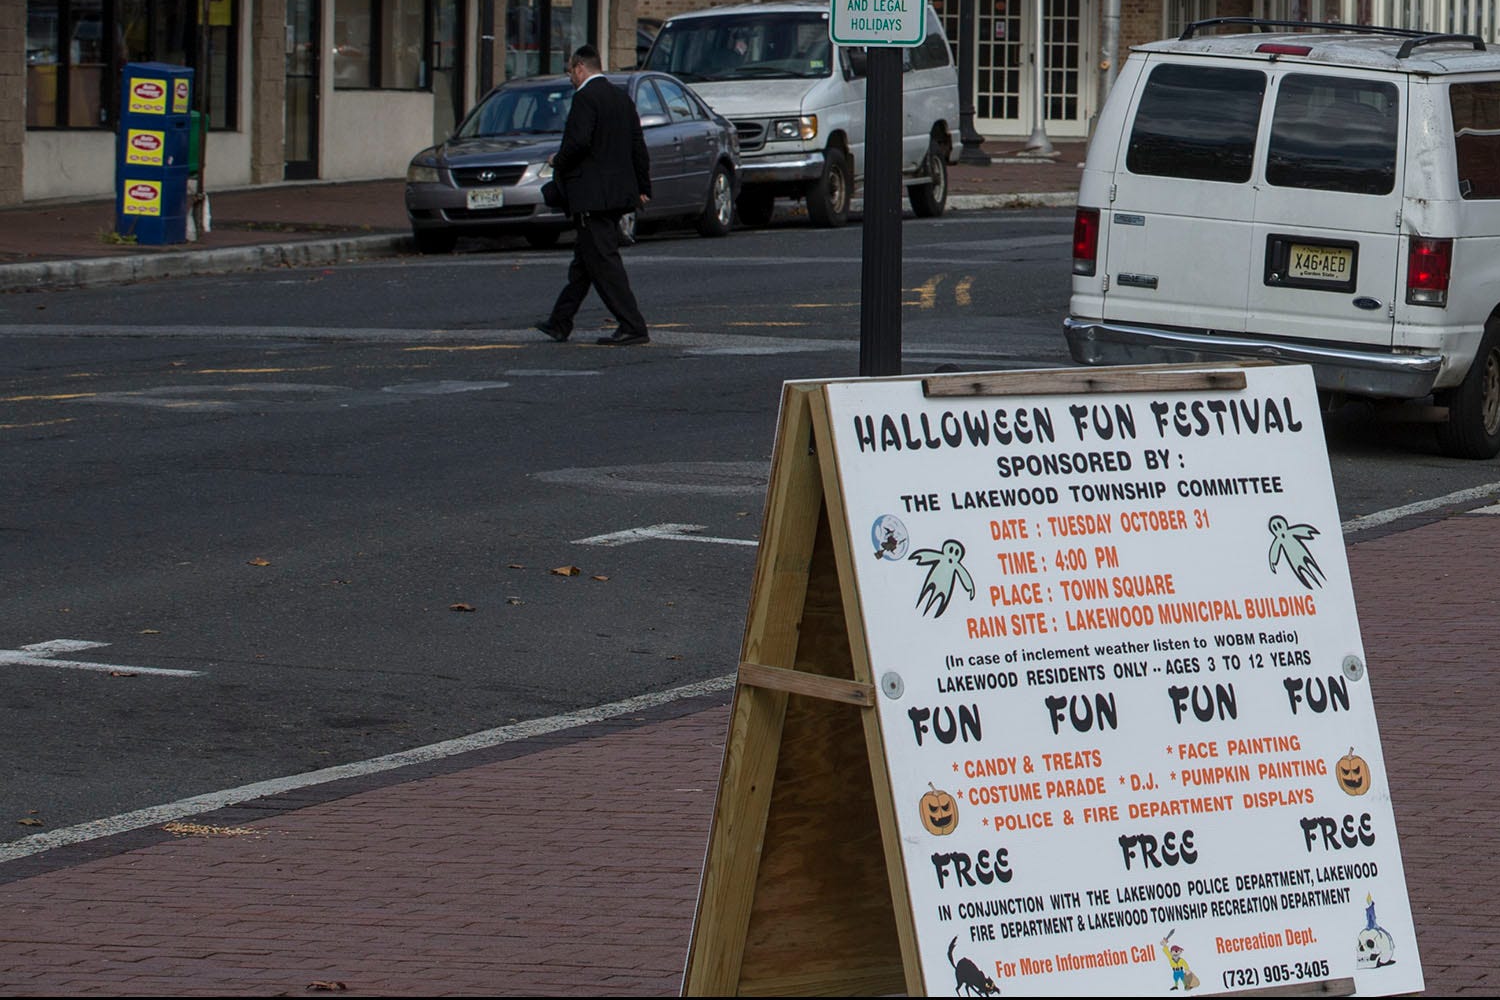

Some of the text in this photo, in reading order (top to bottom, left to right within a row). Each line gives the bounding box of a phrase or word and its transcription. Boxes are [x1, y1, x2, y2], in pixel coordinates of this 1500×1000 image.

[848, 0, 907, 12] AND LEGAL
[851, 18, 902, 31] HOLIDAYS
[853, 396, 1303, 453] HALLOWEEN FUN FESTIVAL
[996, 448, 1170, 479] SPONSORED BY
[900, 476, 1284, 513] THE LAKEWOOD TOWNSHIP COMMITTEE
[990, 509, 1210, 541] DATE TUESDAY OCTOBER 31
[997, 545, 1119, 575] TIME 4:00 PM
[989, 574, 1175, 607] PLACE TOWN SQUARE
[966, 594, 1316, 639] RAIN SITE LAKEWOOD MUNICIPAL BUILDING
[945, 630, 1299, 671] (In case of inclement weather listen to WOBM Radio)
[936, 649, 1312, 694] LAKEWOOD RESIDENTS ONLY AGES 3 TO 12 YEARS
[907, 675, 1350, 747] FUN FUN FUN FUN
[964, 749, 1102, 779] CANDY & TREATS
[1178, 735, 1301, 760] FACE PAINTING
[968, 758, 1327, 806] COSTUME PARADE D.J. PUMPKIN PAINTING
[994, 788, 1314, 832] POLICE & FIRE DEPARTMENT DISPLAYS
[930, 812, 1376, 890] FREE FREE FREE
[937, 862, 1378, 922] IN CONJUNCTION WITH THE LAKEWOOD POLICE DEPARTMENT, LAKEWOOD
[969, 887, 1351, 943] FIRE DEPARTMENT & LAKEWOOD TOWNSHIP RECREATION DEPARTMENT
[1215, 927, 1318, 954] Recreation Dept.
[995, 944, 1156, 978] For More Information Call
[1222, 959, 1330, 989] (732) 905-3405
